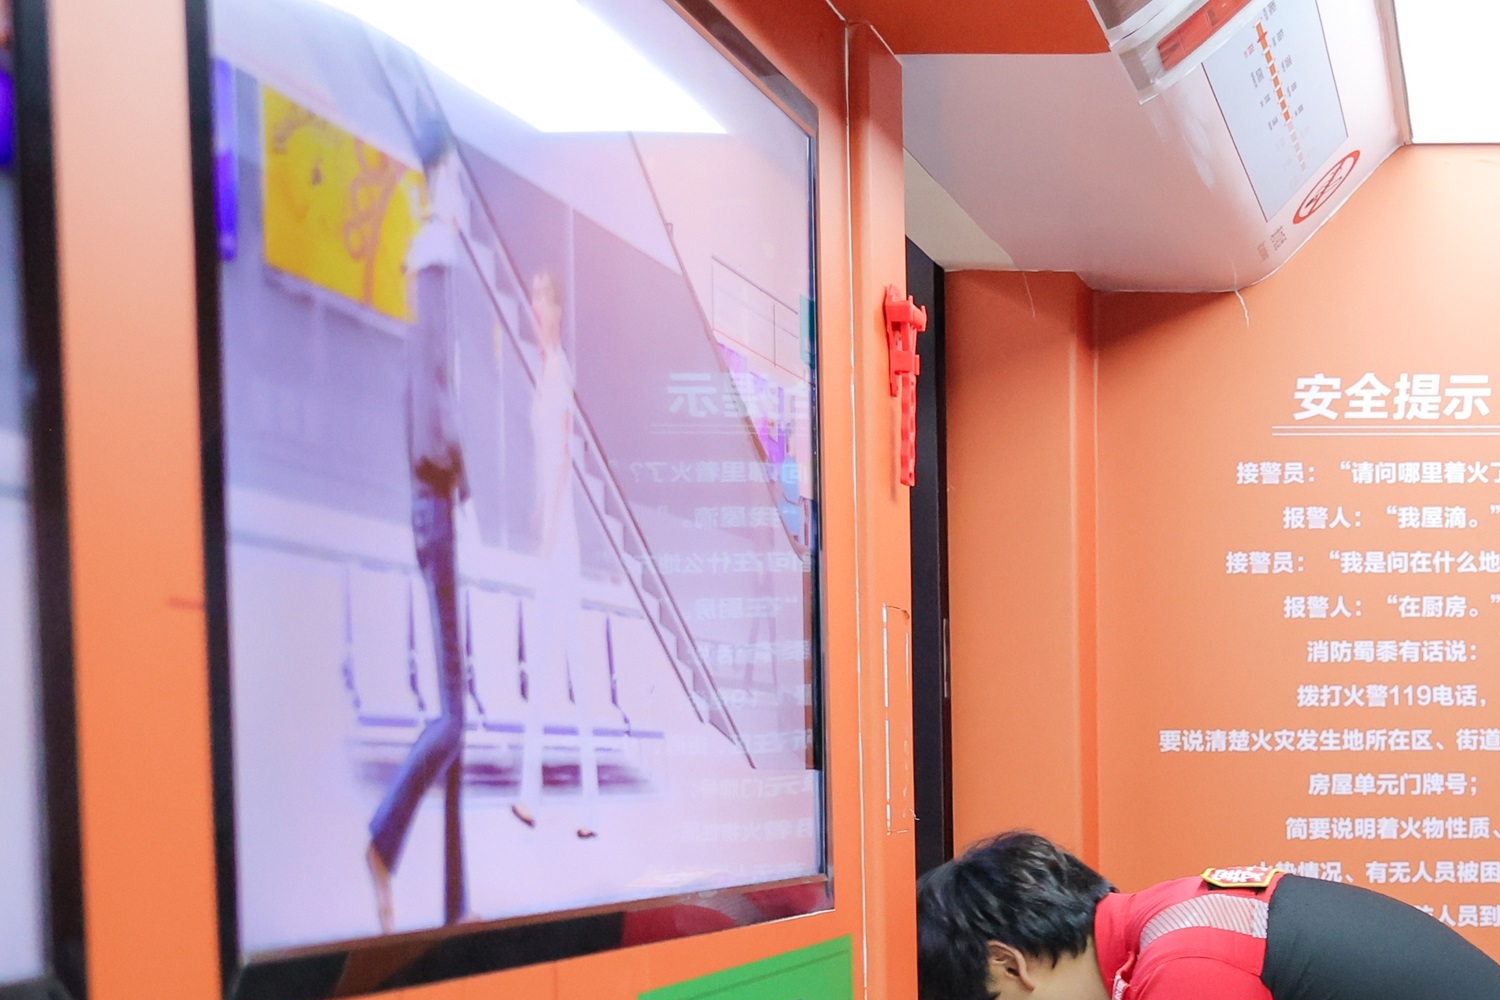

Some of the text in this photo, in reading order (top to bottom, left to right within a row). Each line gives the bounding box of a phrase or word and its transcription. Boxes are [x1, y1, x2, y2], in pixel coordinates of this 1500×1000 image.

[1292, 372, 1492, 421] 安全提示
[1306, 639, 1477, 664] 消防蜀黍有话说：
[1296, 683, 1487, 708] 拨打火警119电话，
[1307, 771, 1478, 797] 房屋单元门牌号；
